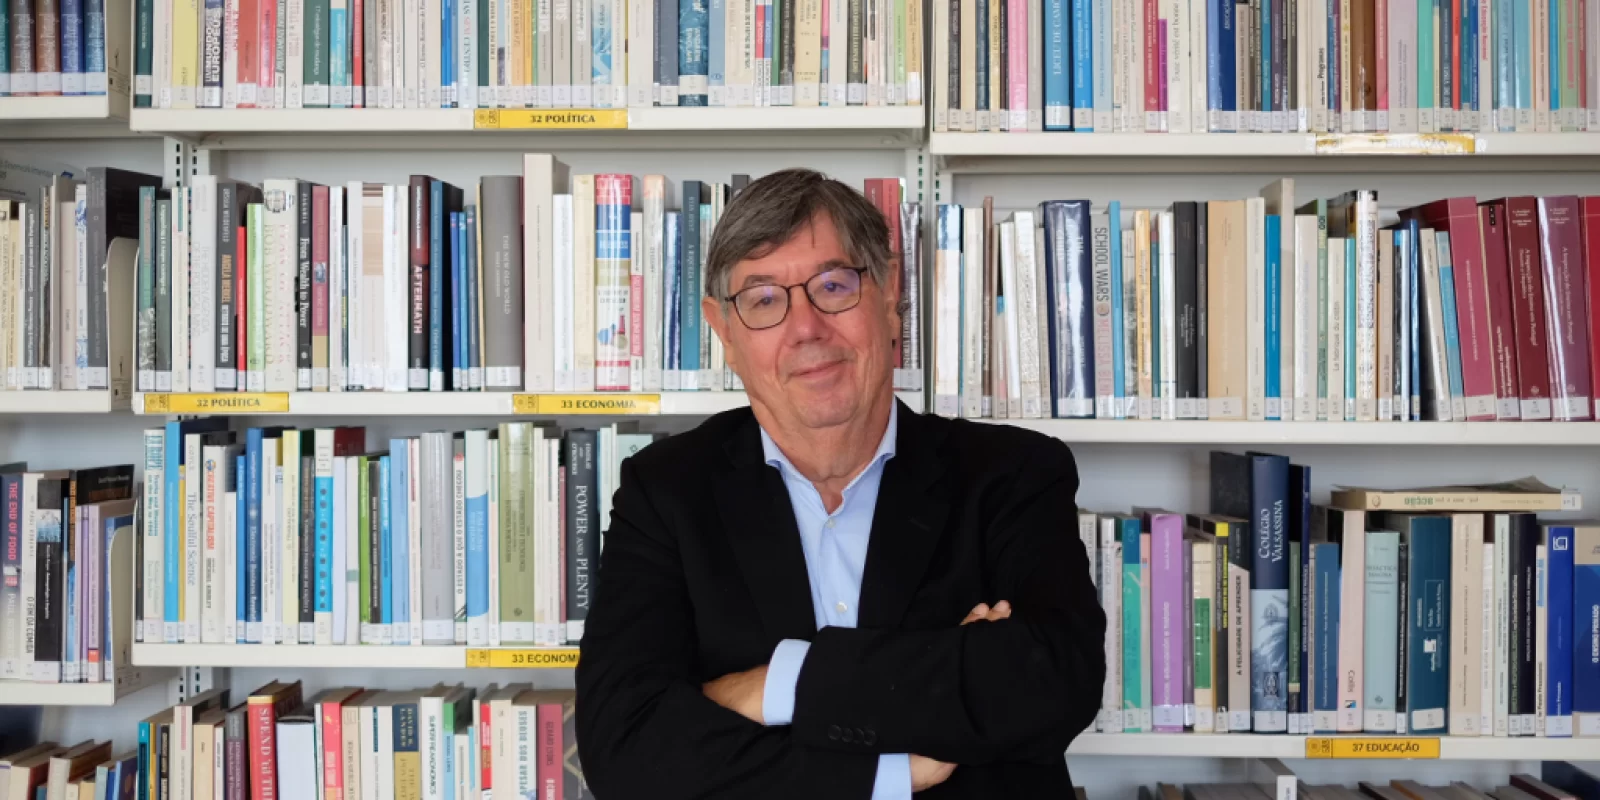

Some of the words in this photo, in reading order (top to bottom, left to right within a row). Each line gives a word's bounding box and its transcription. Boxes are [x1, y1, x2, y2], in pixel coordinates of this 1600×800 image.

[1052, 28, 1061, 42] DE
[544, 113, 596, 123] POLÍTICA
[264, 224, 274, 256] BOB
[300, 237, 309, 259] From
[1095, 227, 1108, 267] SCHOOL
[222, 254, 232, 278] ANGELA
[300, 261, 309, 290] Wealth
[222, 279, 232, 303] MERKEL
[300, 292, 309, 300] to
[1096, 269, 1109, 302] WARS
[414, 264, 422, 334] AFTERMATH
[264, 264, 274, 365] WOODWARD
[300, 302, 309, 327] Power
[1333, 322, 1339, 331] du
[1529, 323, 1537, 346] Portugal
[1566, 321, 1574, 344] Portugal
[1097, 319, 1111, 365] MELISSA
[197, 399, 208, 407] 32
[210, 398, 260, 407] POLÍTICA
[561, 400, 572, 408] 33
[576, 400, 636, 408] ECONOMIA
[9, 482, 17, 499] THE
[188, 492, 197, 510] The
[1404, 496, 1434, 506] acção
[9, 501, 17, 519] END
[576, 485, 588, 534] POWER
[8, 522, 17, 533] OF
[188, 514, 197, 548] Soulful
[1258, 508, 1271, 558] COLÉGIO
[1272, 500, 1283, 562] VALSASSINA
[8, 536, 17, 560] FOOD
[456, 537, 464, 550] QUE
[188, 550, 197, 586] Science
[576, 558, 588, 610] PLENTY
[26, 603, 34, 617] FIM
[1236, 617, 1242, 625] DE
[26, 618, 34, 627] DA
[26, 628, 34, 653] COMIDA
[512, 654, 524, 663] 33
[260, 708, 271, 755] SPEND
[519, 711, 527, 741] DEUSES
[1353, 743, 1363, 752] 37
[1366, 742, 1420, 753] EDUCAÇÃO
